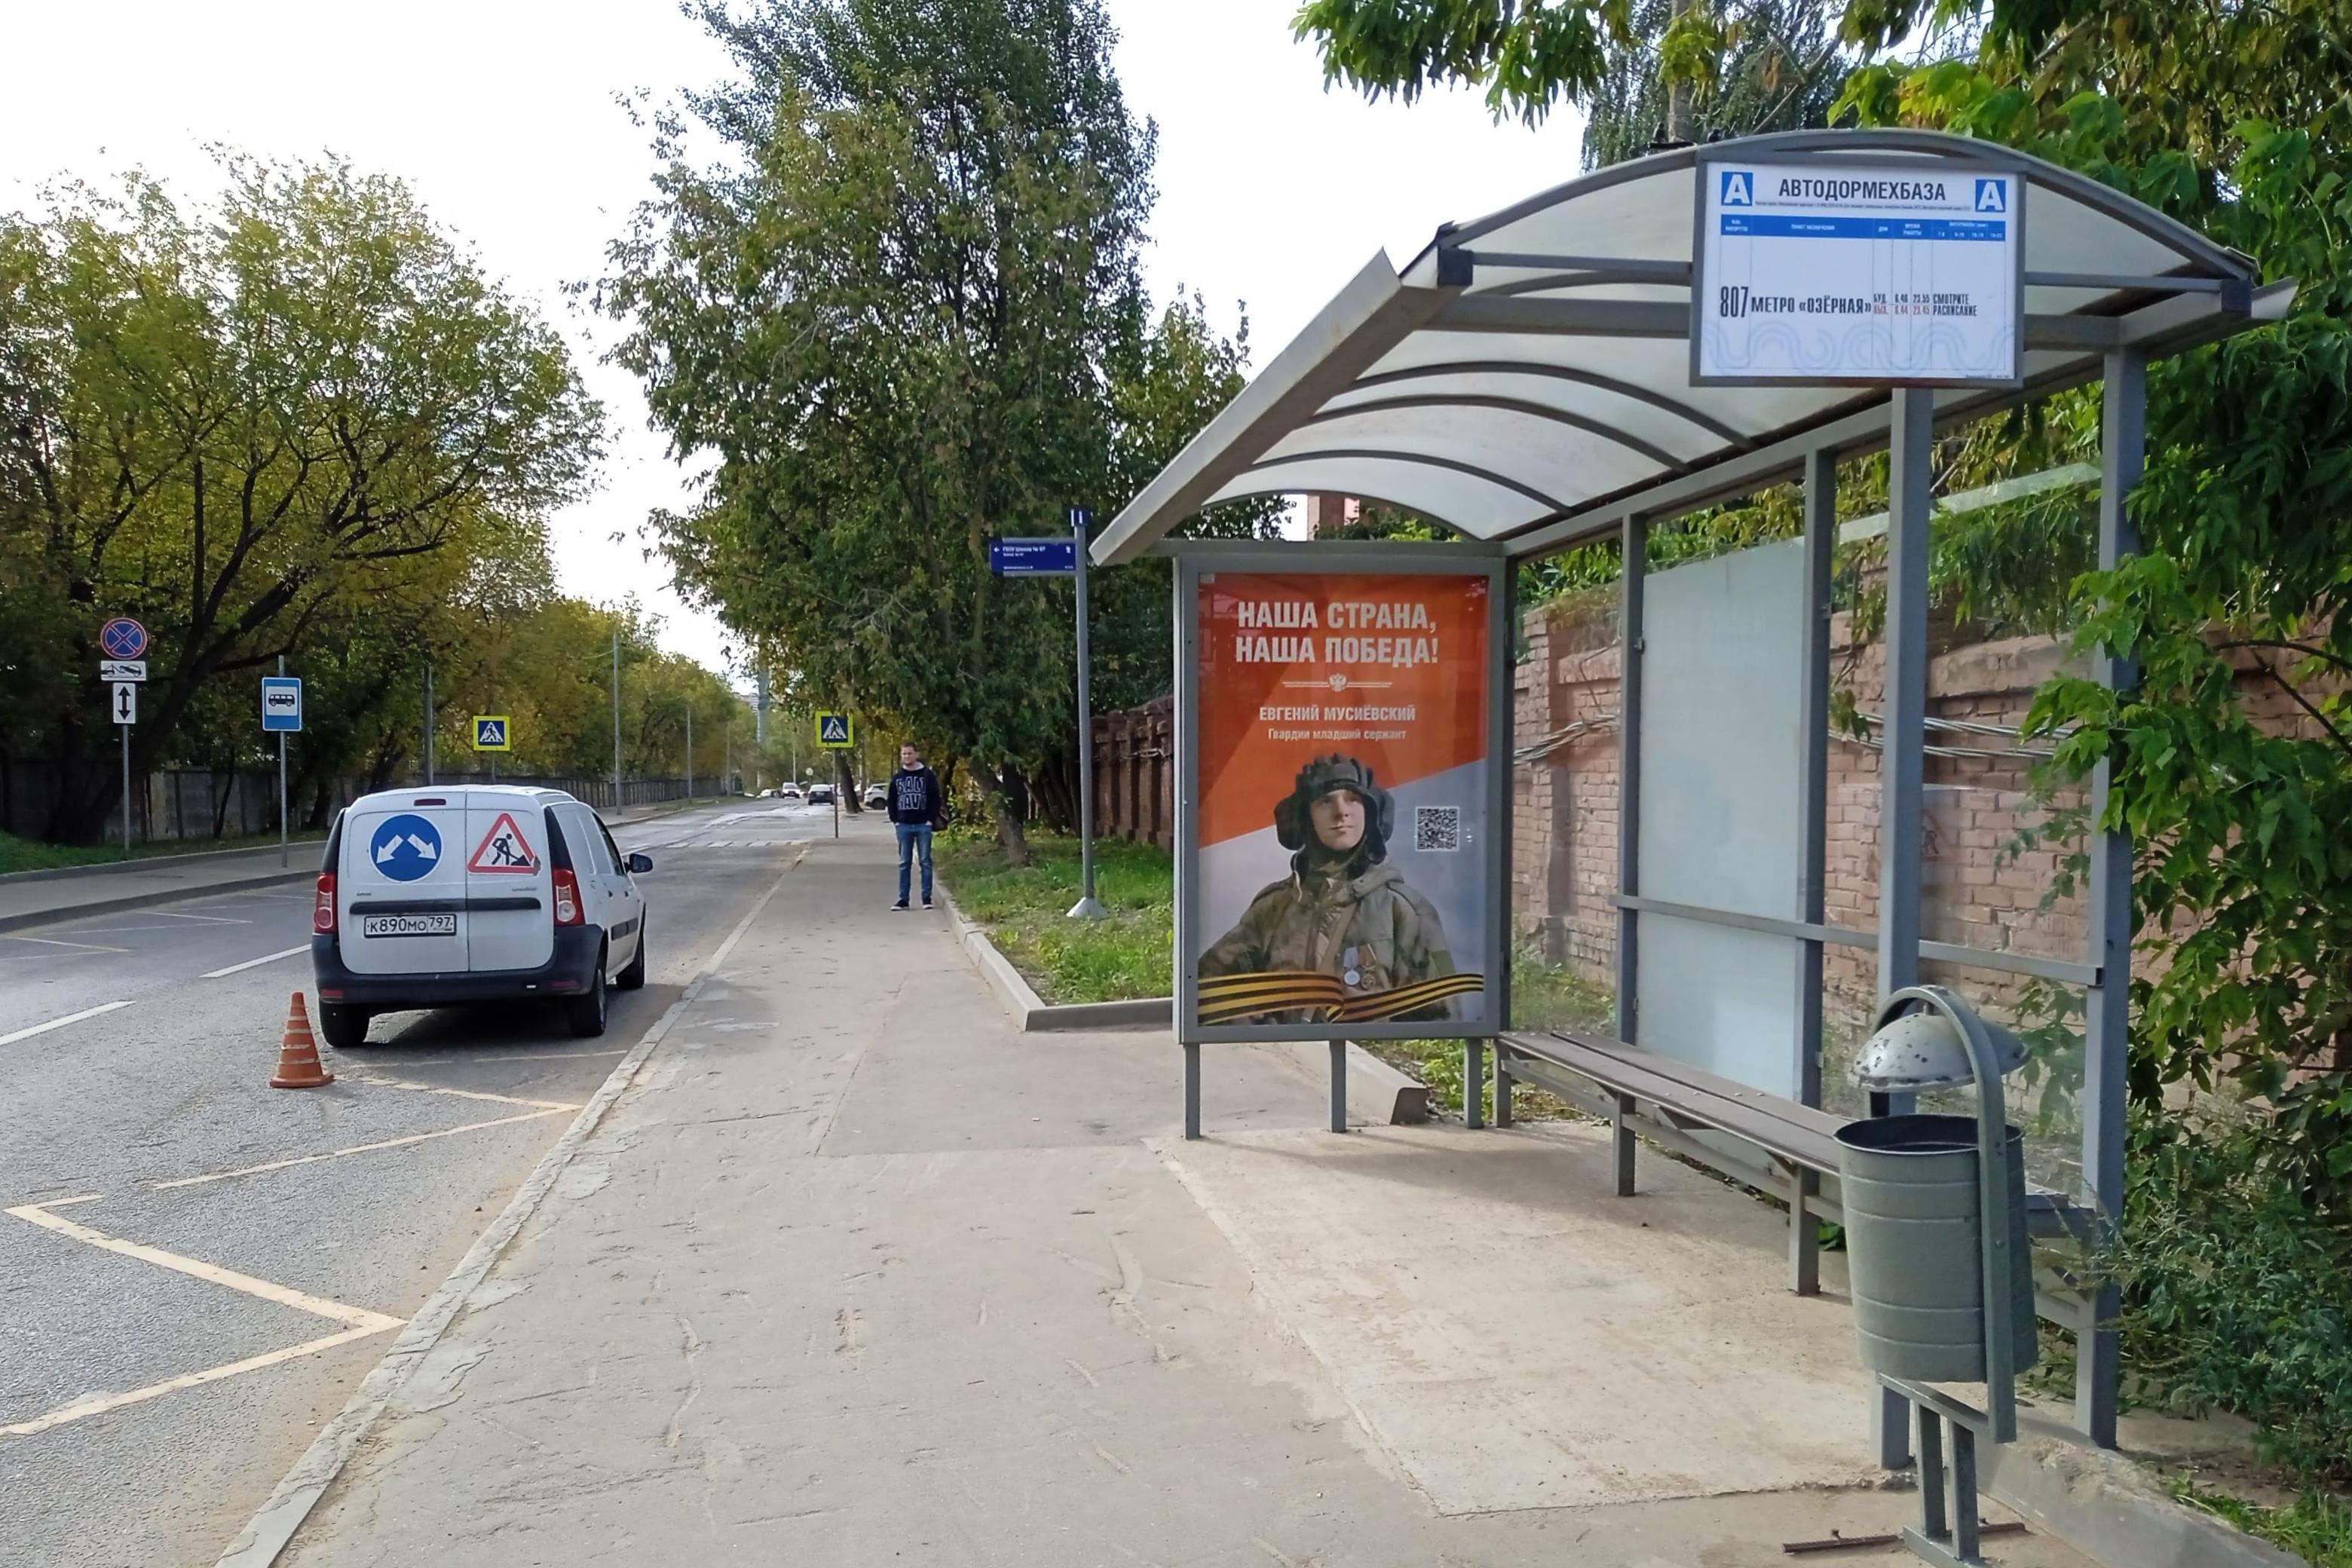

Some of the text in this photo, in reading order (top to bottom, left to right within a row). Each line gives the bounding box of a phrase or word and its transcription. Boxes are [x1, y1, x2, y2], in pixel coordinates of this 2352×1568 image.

[1779, 178, 1946, 201] АВТОДОРМЕХБАЗА
[1720, 286, 1749, 318] 807
[1751, 295, 1872, 314] МЕТРО «ОЗЁРНАЯ»
[1933, 293, 1969, 305] СМОТРИТЕ
[1933, 305, 1977, 317] РАСПИСАНИЕ
[1238, 602, 1436, 633] НАША СТРАНА,
[1236, 636, 1438, 668] НАША ПОБЕДА!
[1260, 704, 1319, 721] ЕВГЕНИЙ
[1268, 728, 1407, 742] Гвардии младший сержант
[428, 917, 451, 927] 797
